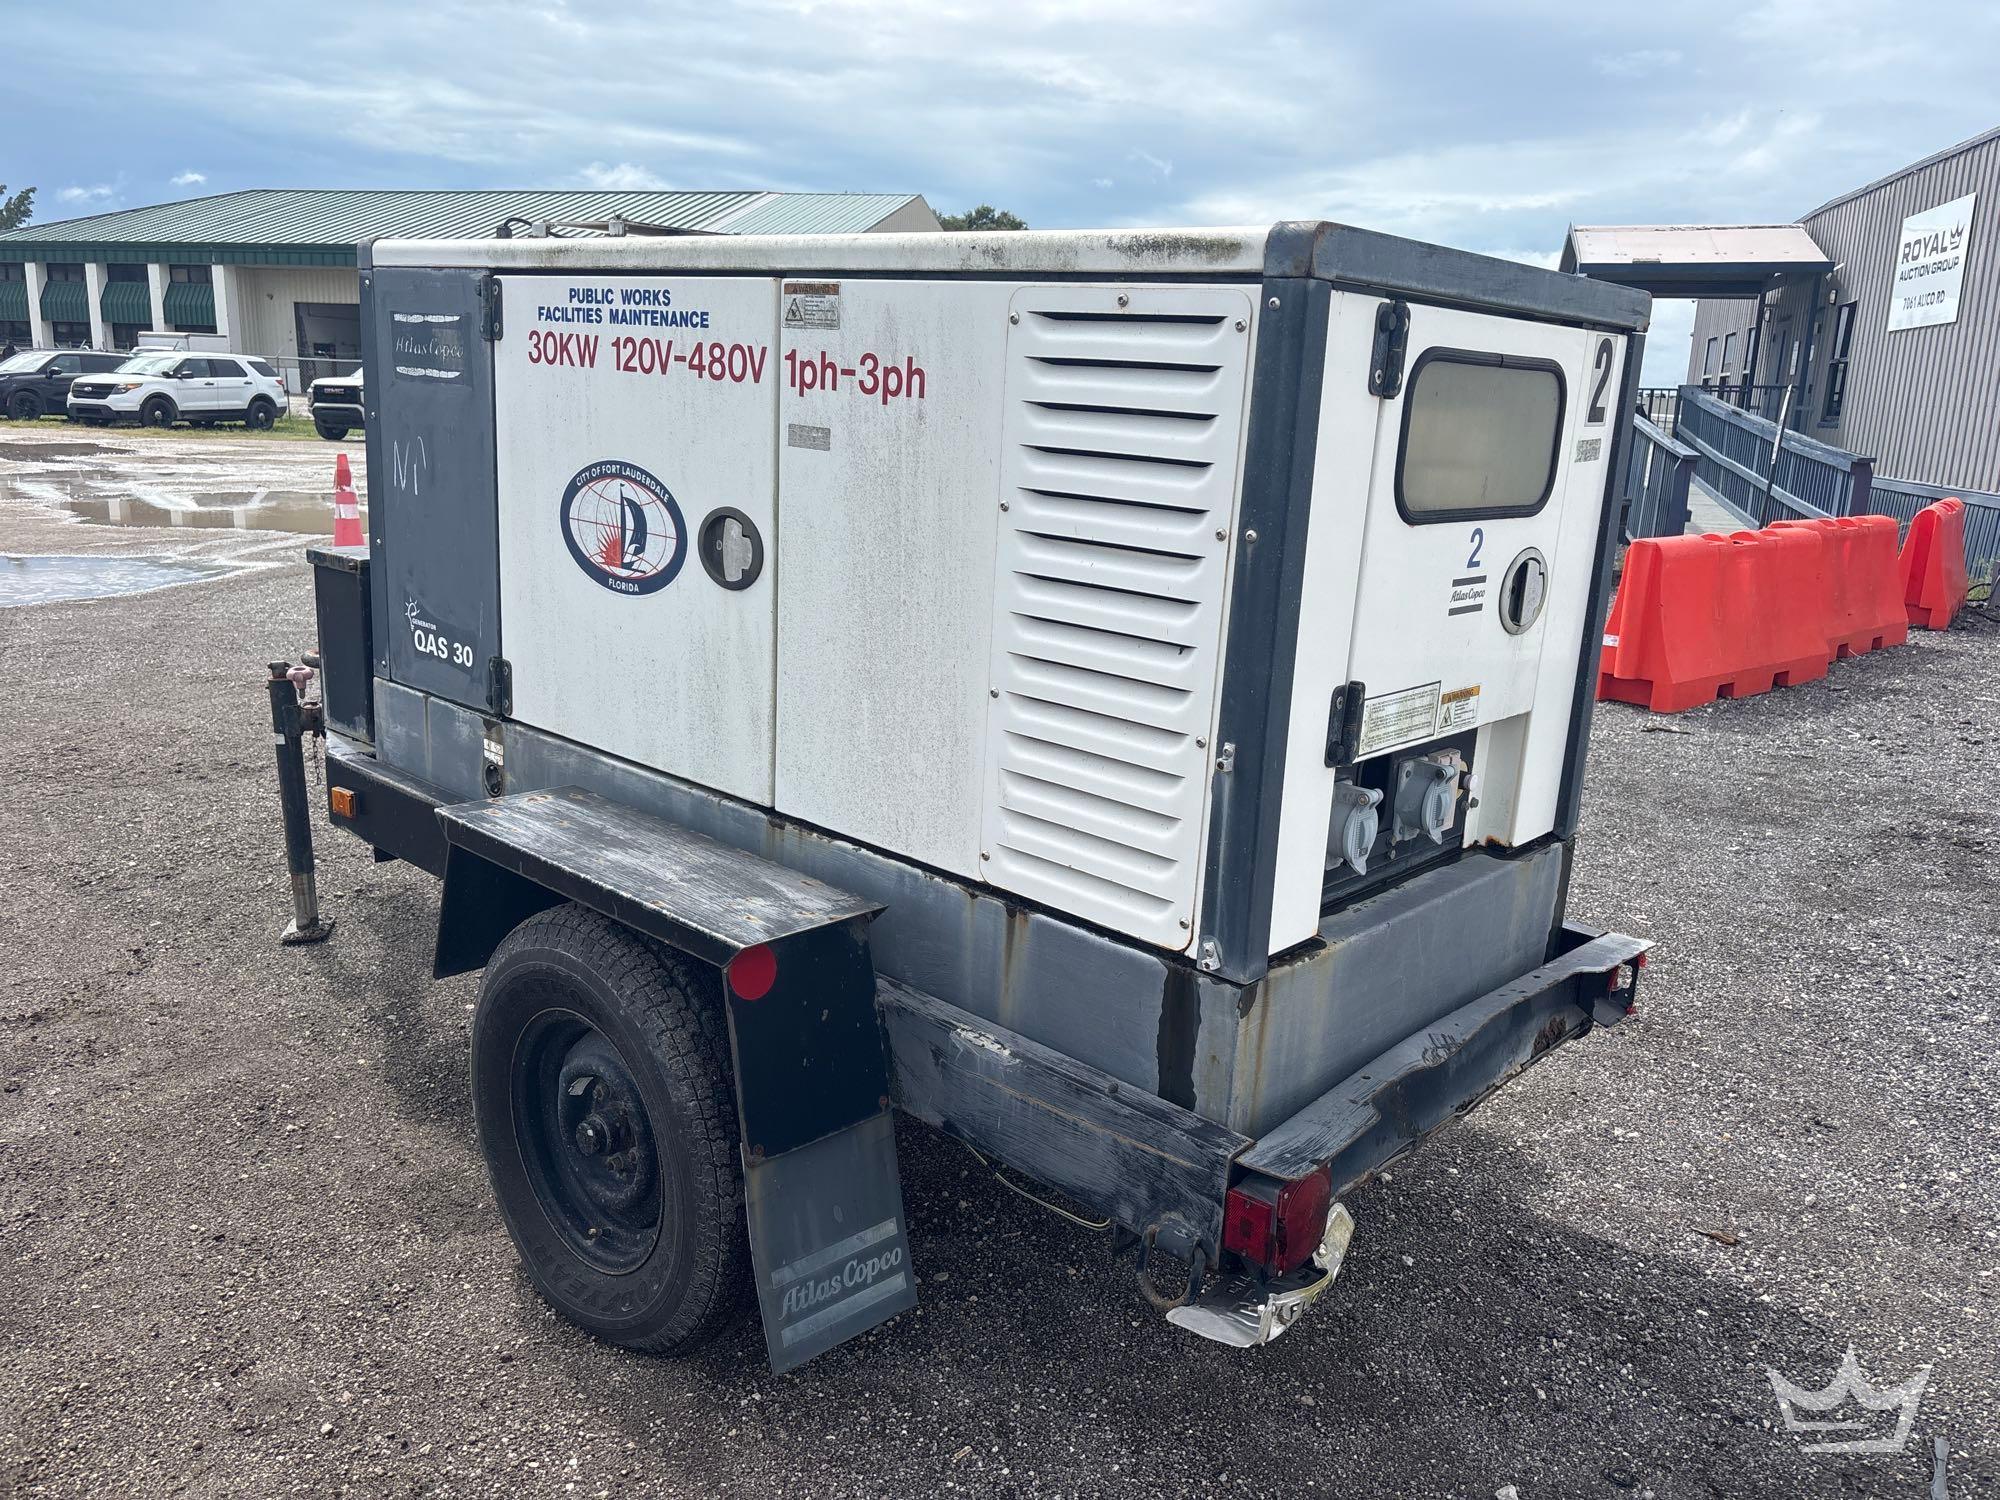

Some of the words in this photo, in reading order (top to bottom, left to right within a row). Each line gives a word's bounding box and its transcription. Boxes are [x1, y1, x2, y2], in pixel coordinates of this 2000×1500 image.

[1901, 230, 1948, 265] ROYAL
[1898, 262, 1931, 283] AUCTION
[1931, 256, 1960, 274] GROUP
[569, 287, 615, 305] PUBLIC
[620, 289, 671, 307] WORKS
[1902, 295, 1917, 311] 7061
[1935, 290, 1946, 304] RD
[538, 306, 603, 324] FACILITIES
[609, 308, 710, 329] MAINTENANCE
[528, 329, 599, 368] 30KW
[611, 336, 768, 384] 120V-480V
[784, 349, 926, 405] 1ph-3ph
[1587, 337, 1613, 423] 2
[576, 470, 591, 487] CITY
[591, 466, 601, 477] OF
[601, 464, 621, 475] FORT
[621, 465, 670, 503] LAUDERDALE
[1466, 527, 1484, 569] 2
[608, 578, 640, 593] FLORIDA
[411, 617, 437, 631] GENERATOR
[414, 629, 448, 659] QAS
[452, 642, 474, 668] 30
